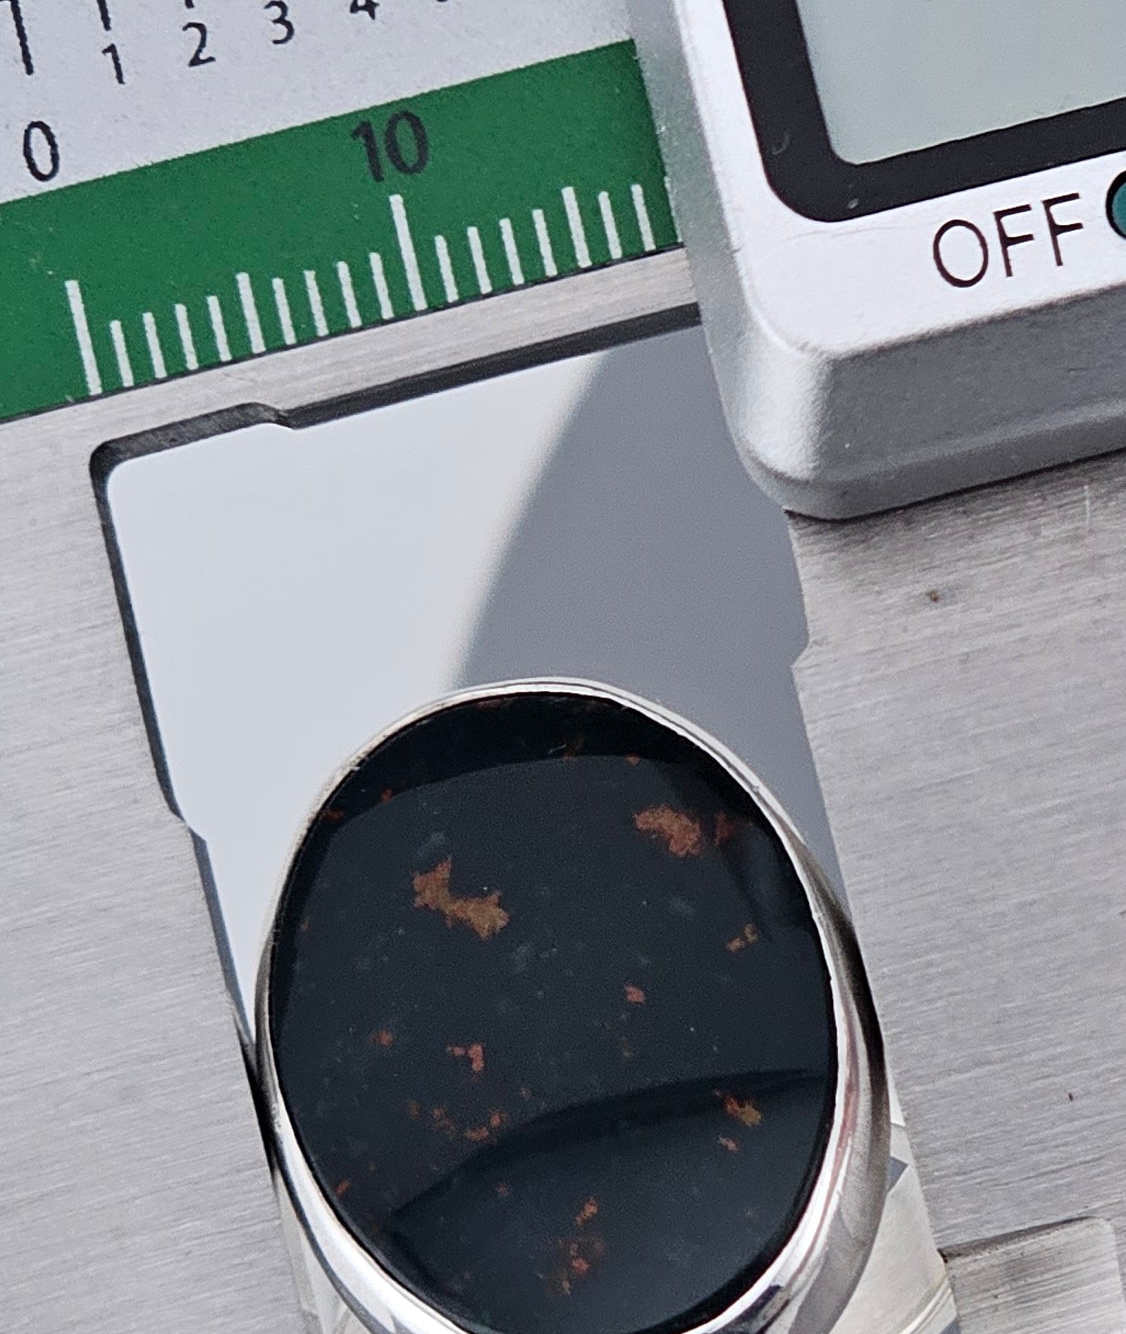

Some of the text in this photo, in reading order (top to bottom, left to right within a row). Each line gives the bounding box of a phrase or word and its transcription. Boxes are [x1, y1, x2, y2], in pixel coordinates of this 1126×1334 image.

[101, 43, 125, 85] 1
[182, 22, 216, 68] 2
[264, 0, 295, 45] 3
[22, 120, 60, 183] 0
[348, 107, 431, 184] 10
[932, 192, 1085, 288] OFF
